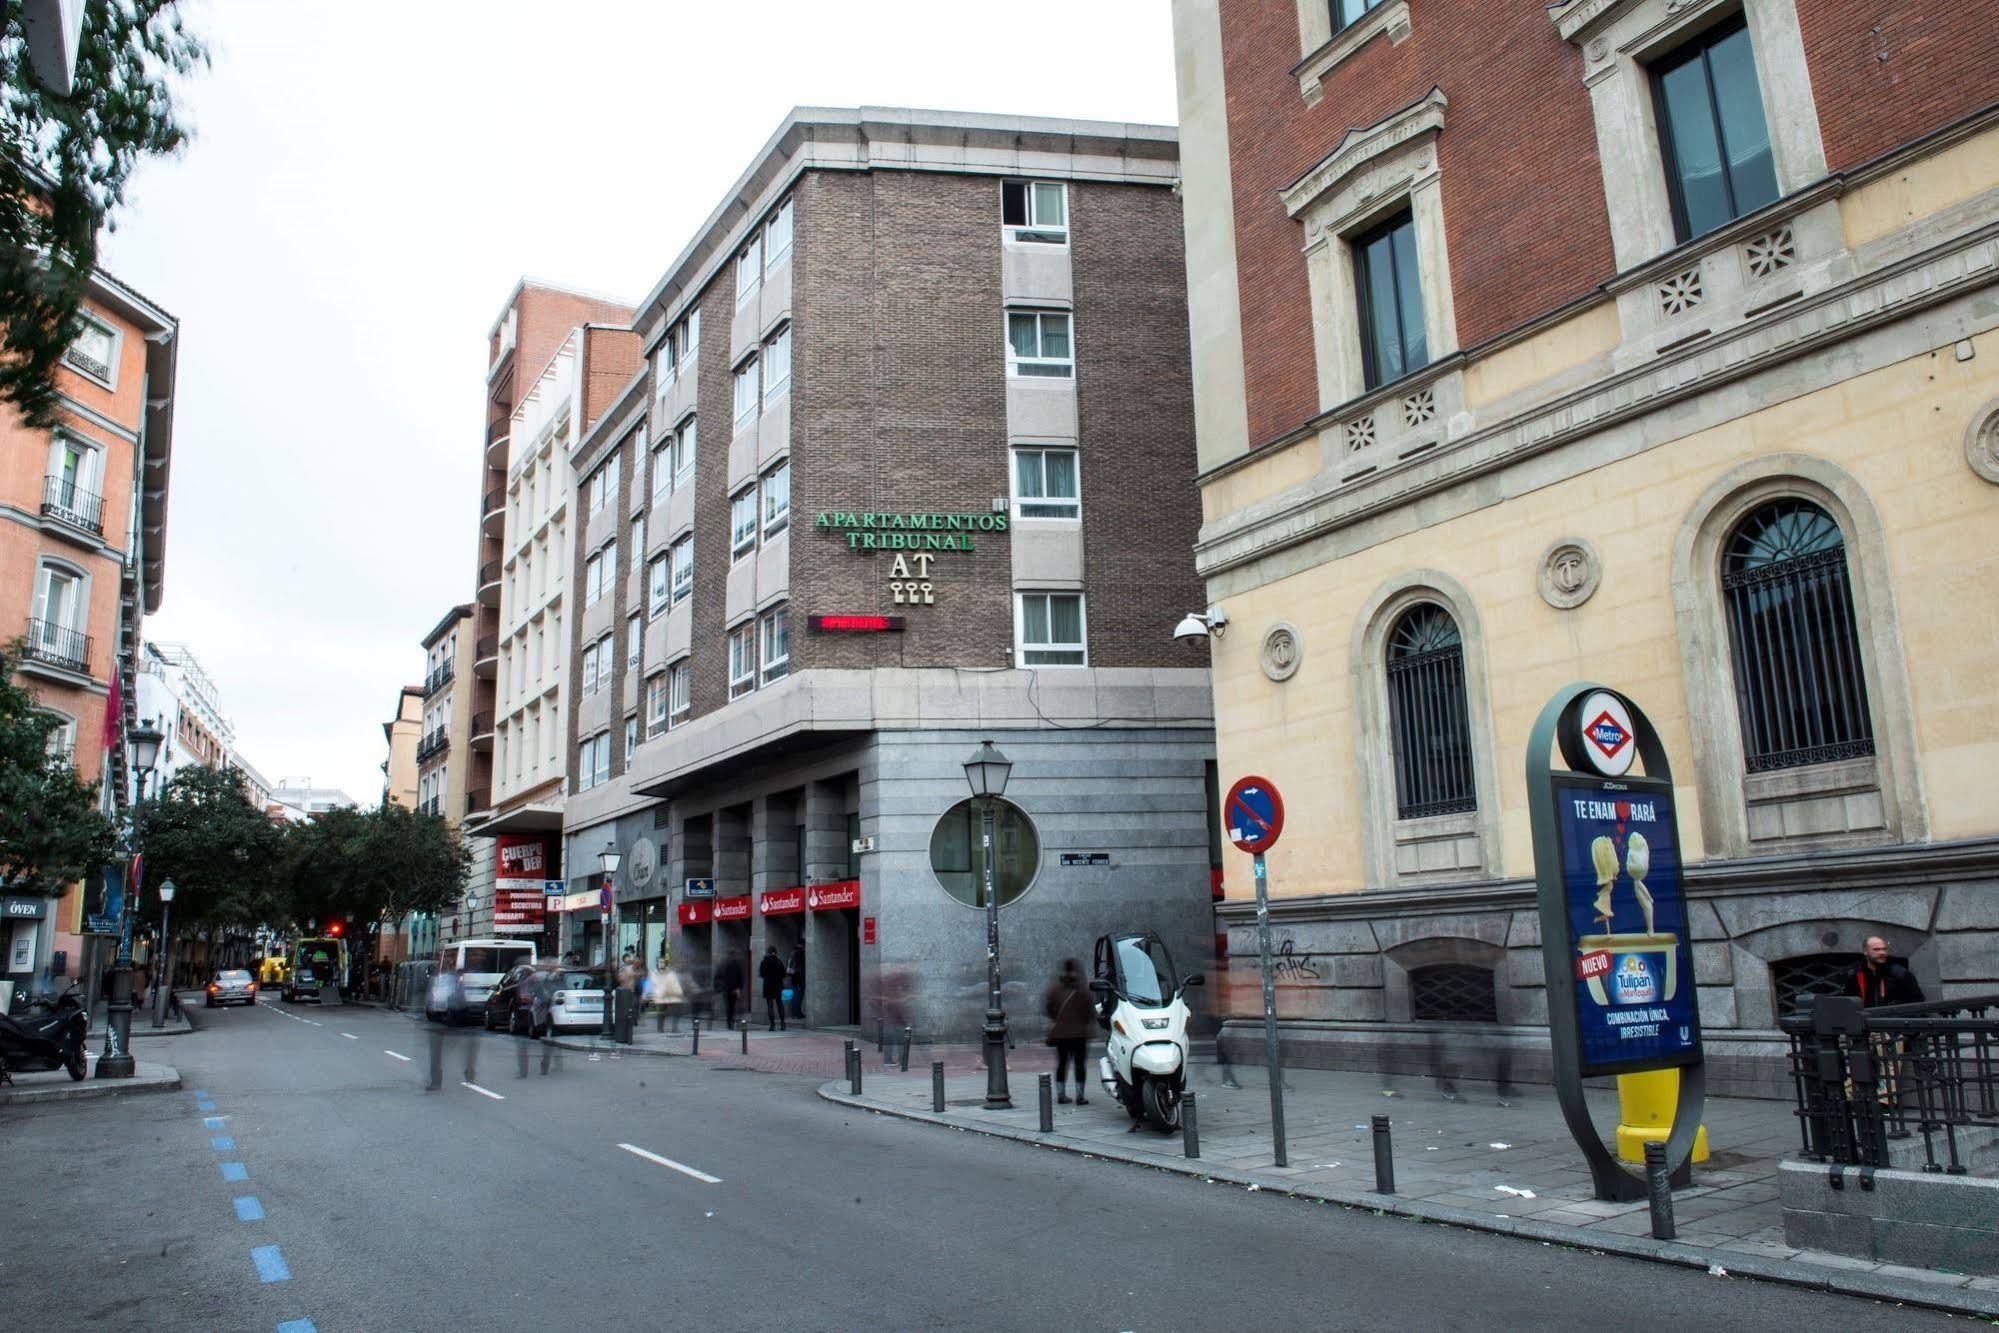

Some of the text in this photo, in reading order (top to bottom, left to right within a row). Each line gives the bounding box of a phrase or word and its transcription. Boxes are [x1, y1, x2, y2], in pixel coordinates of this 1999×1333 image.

[815, 511, 1008, 531] APARTAMENTOS
[846, 532, 975, 550] TRIBUNAL
[888, 552, 935, 579] AT
[1595, 727, 1621, 742] Metro
[1574, 800, 1588, 819] TE
[502, 843, 543, 861] CUERPO
[769, 893, 800, 911] Santander
[819, 887, 853, 905] Santander
[721, 901, 747, 916] Santander
[1582, 954, 1608, 975] NUEVO
[1618, 974, 1651, 991] Tulipán
[1606, 1009, 1649, 1025] COMBINACIÓN
[1620, 1024, 1660, 1040] IRRESISTIBLE
